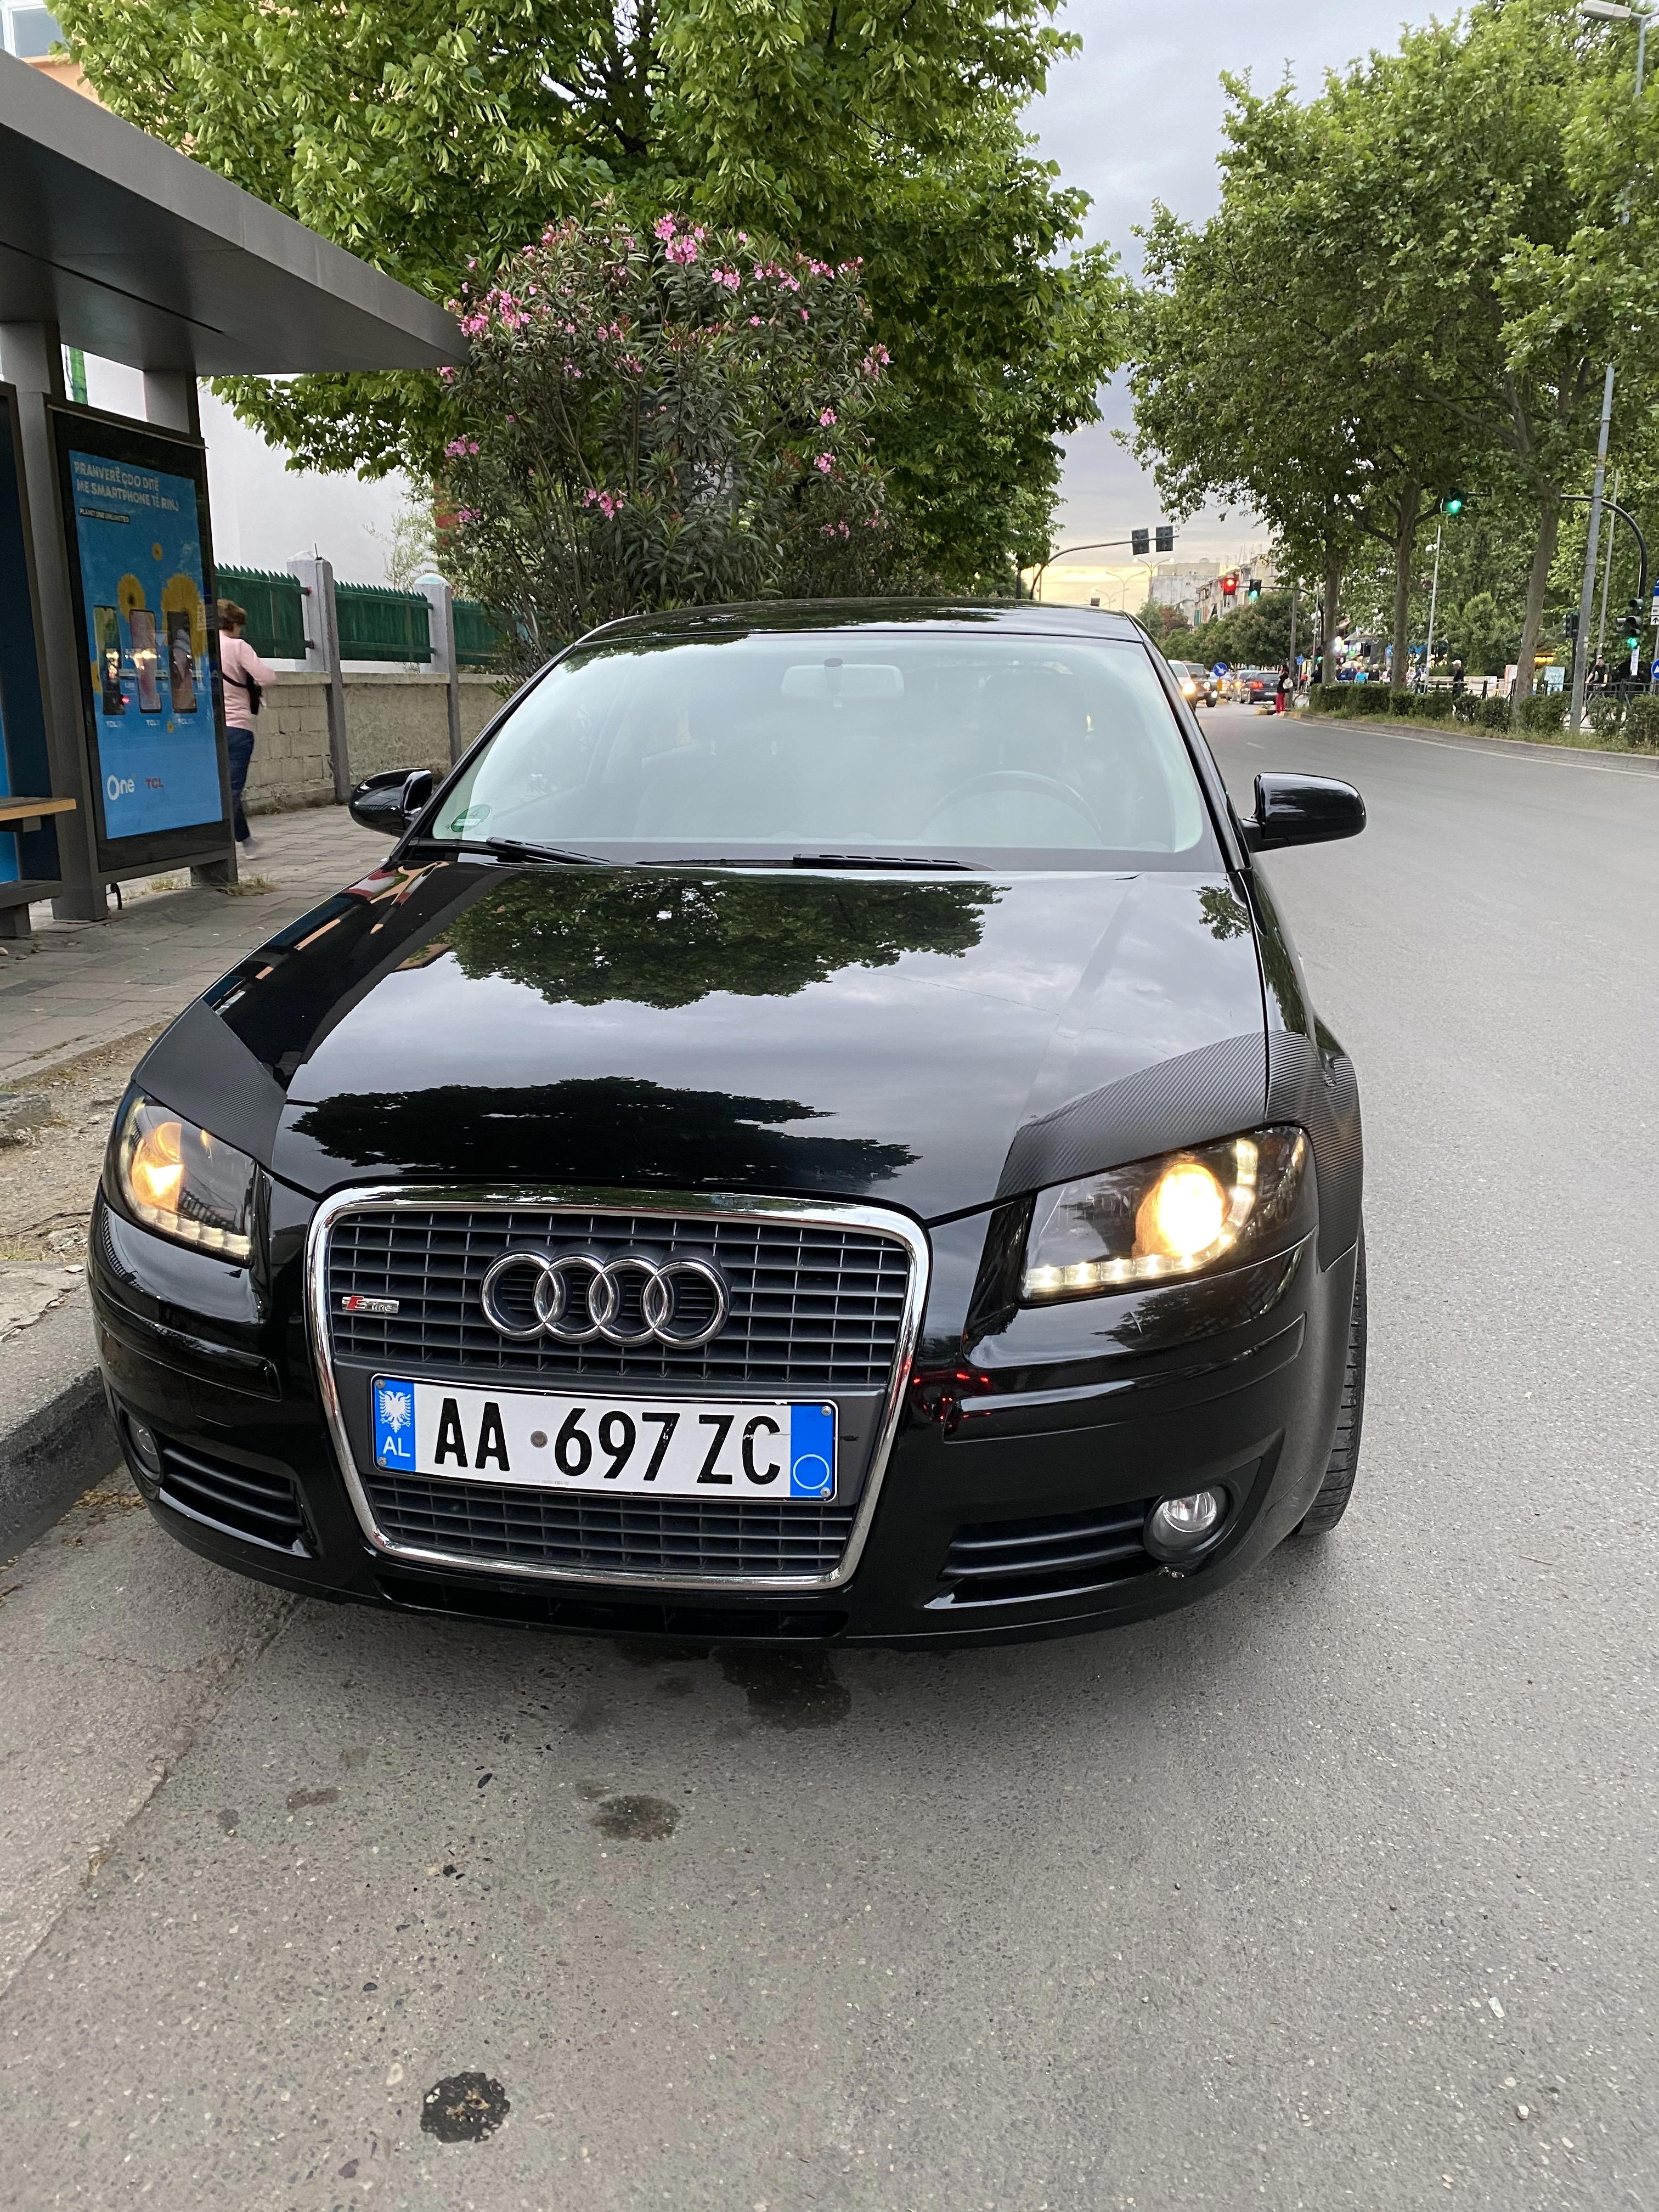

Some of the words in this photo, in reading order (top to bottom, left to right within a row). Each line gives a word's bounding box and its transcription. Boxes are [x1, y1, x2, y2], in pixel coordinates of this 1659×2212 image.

[74, 461, 121, 483] PRANVERË
[121, 471, 141, 487] ÇDO
[143, 476, 159, 492] DITË
[77, 479, 90, 494] ME
[91, 482, 151, 506] SMARTPHONE
[107, 775, 135, 800] One
[145, 777, 164, 789] TCL
[382, 1436, 410, 1458] AL
[434, 1397, 511, 1471] AA
[554, 1407, 681, 1481] 697
[696, 1414, 781, 1486] ZC
